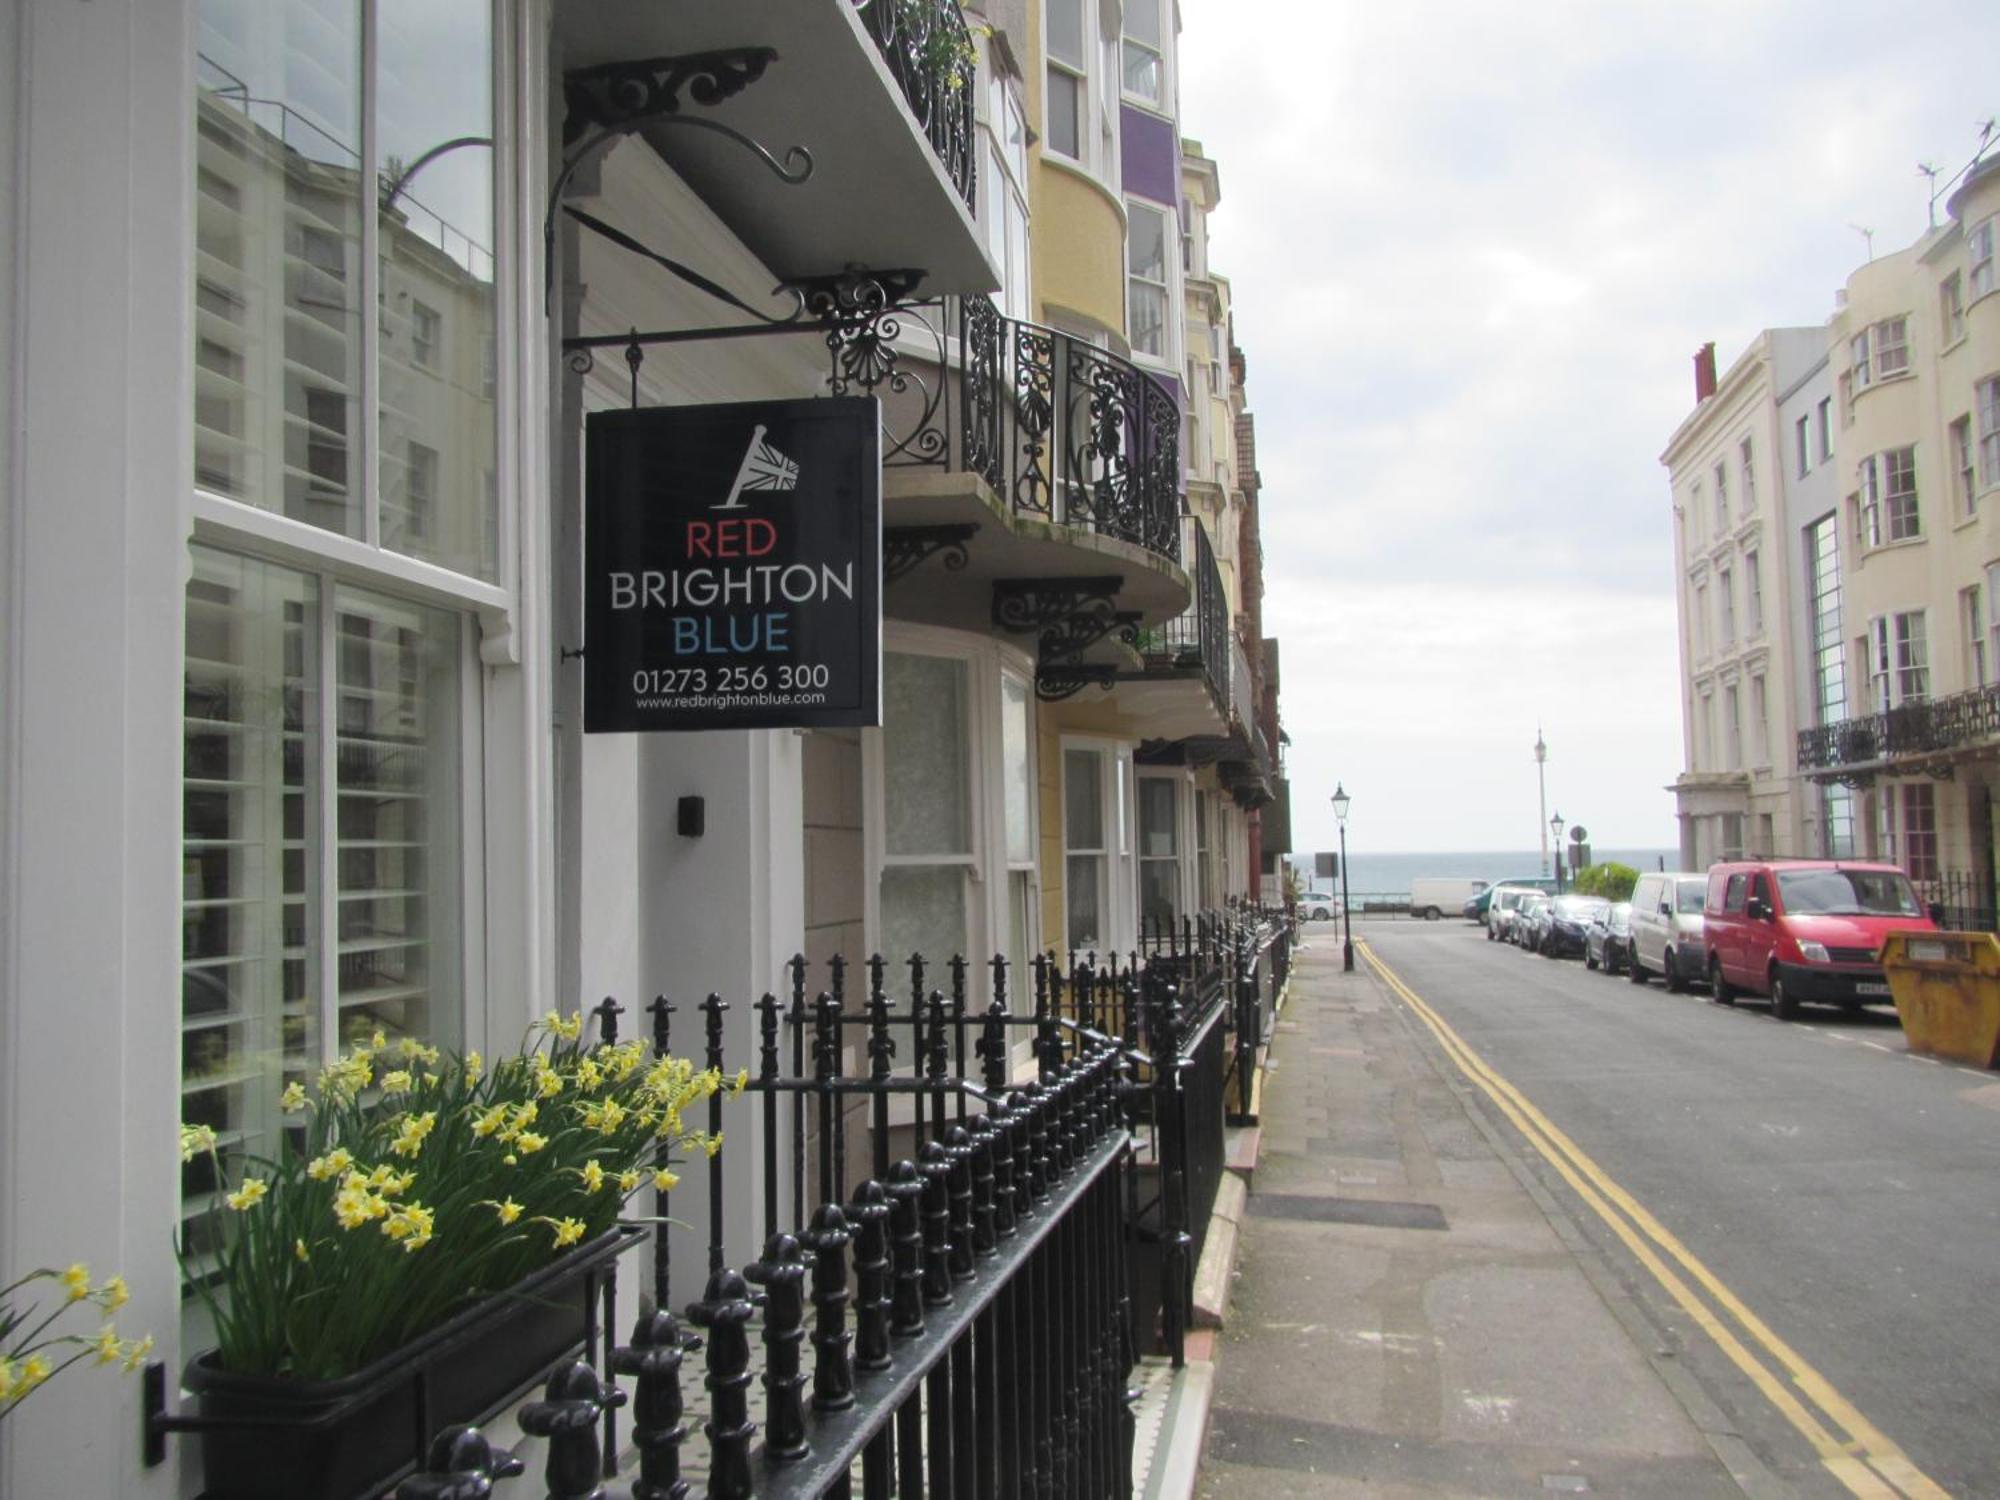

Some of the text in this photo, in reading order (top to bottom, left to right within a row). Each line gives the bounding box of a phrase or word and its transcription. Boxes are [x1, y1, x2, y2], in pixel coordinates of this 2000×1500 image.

[686, 519, 777, 558] RED
[608, 562, 853, 609] BRIGHTON
[672, 613, 788, 654] BLUE
[632, 664, 829, 694] 01273 256 300
[636, 692, 825, 709] www.redbrightonblue.com
